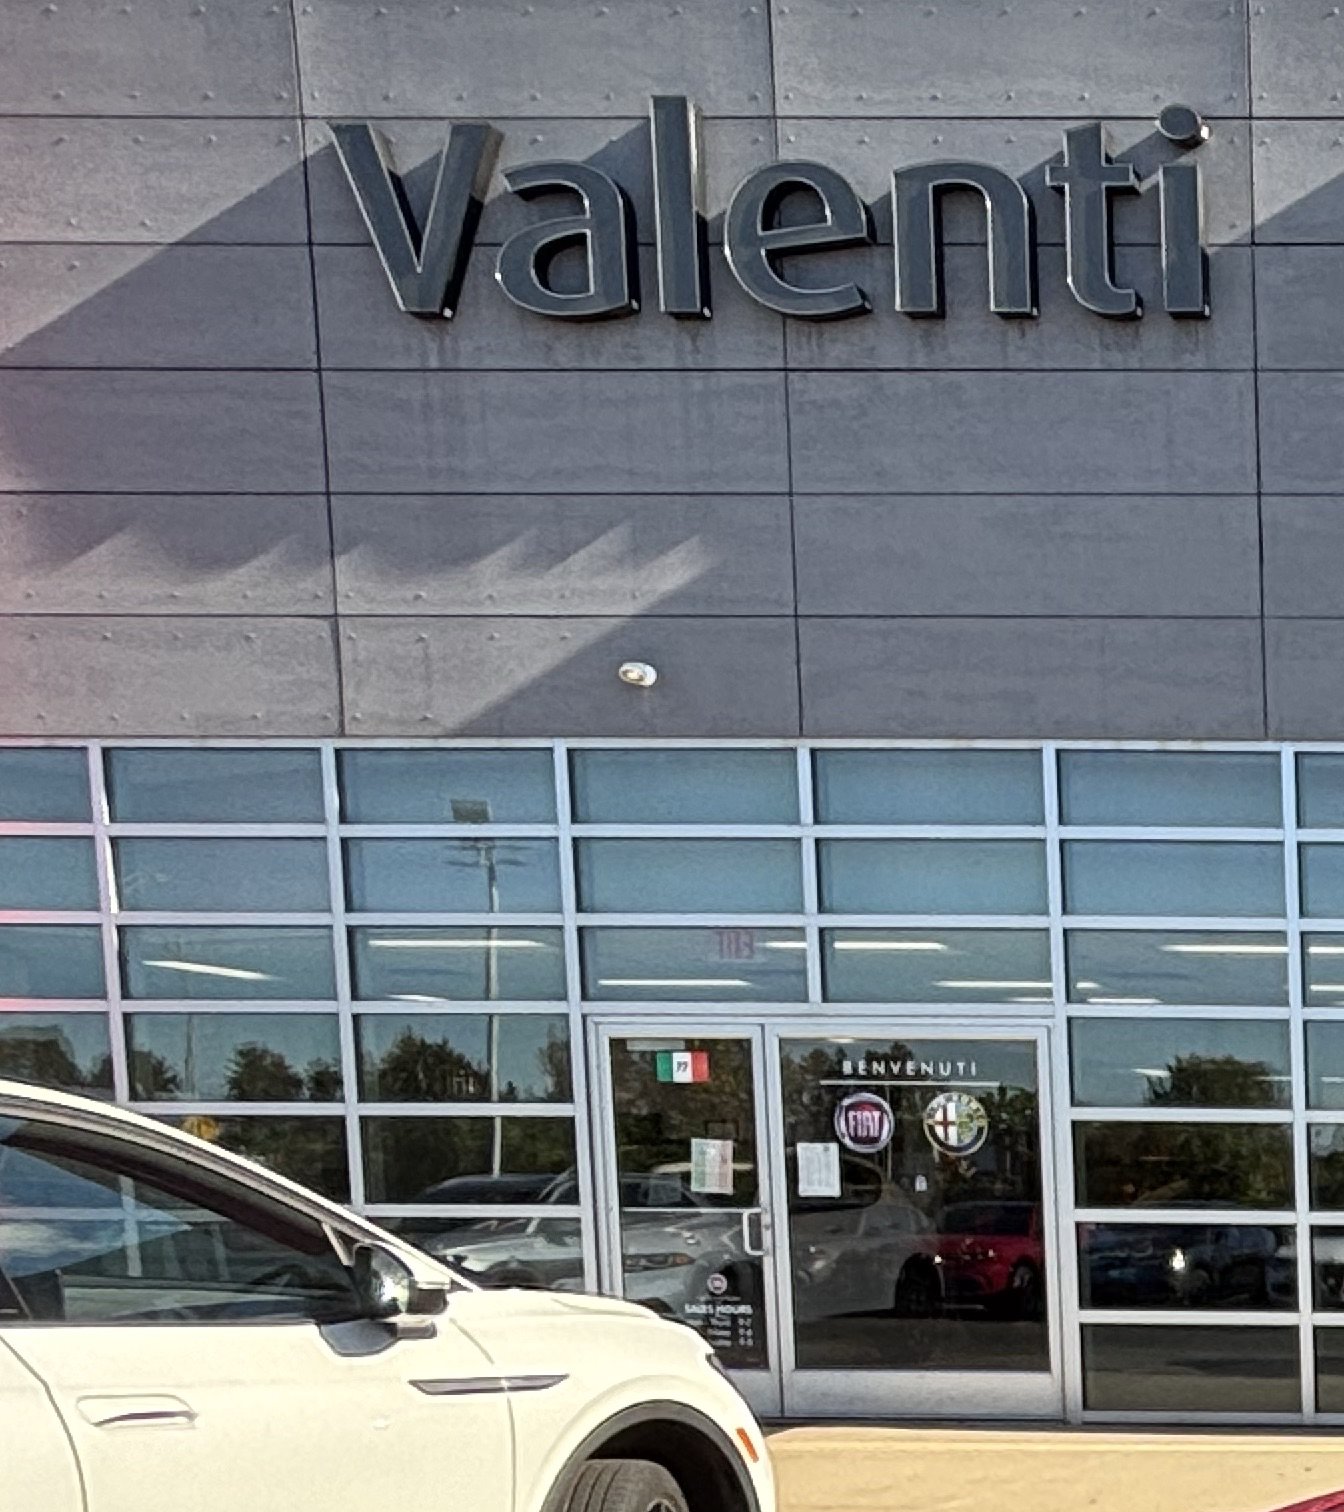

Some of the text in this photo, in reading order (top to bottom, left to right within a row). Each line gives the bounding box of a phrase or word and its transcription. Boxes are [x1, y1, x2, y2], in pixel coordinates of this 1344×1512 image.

[328, 95, 1212, 318] Valenti
[842, 1060, 976, 1077] BENVENUTI
[847, 1110, 881, 1138] FIAT
